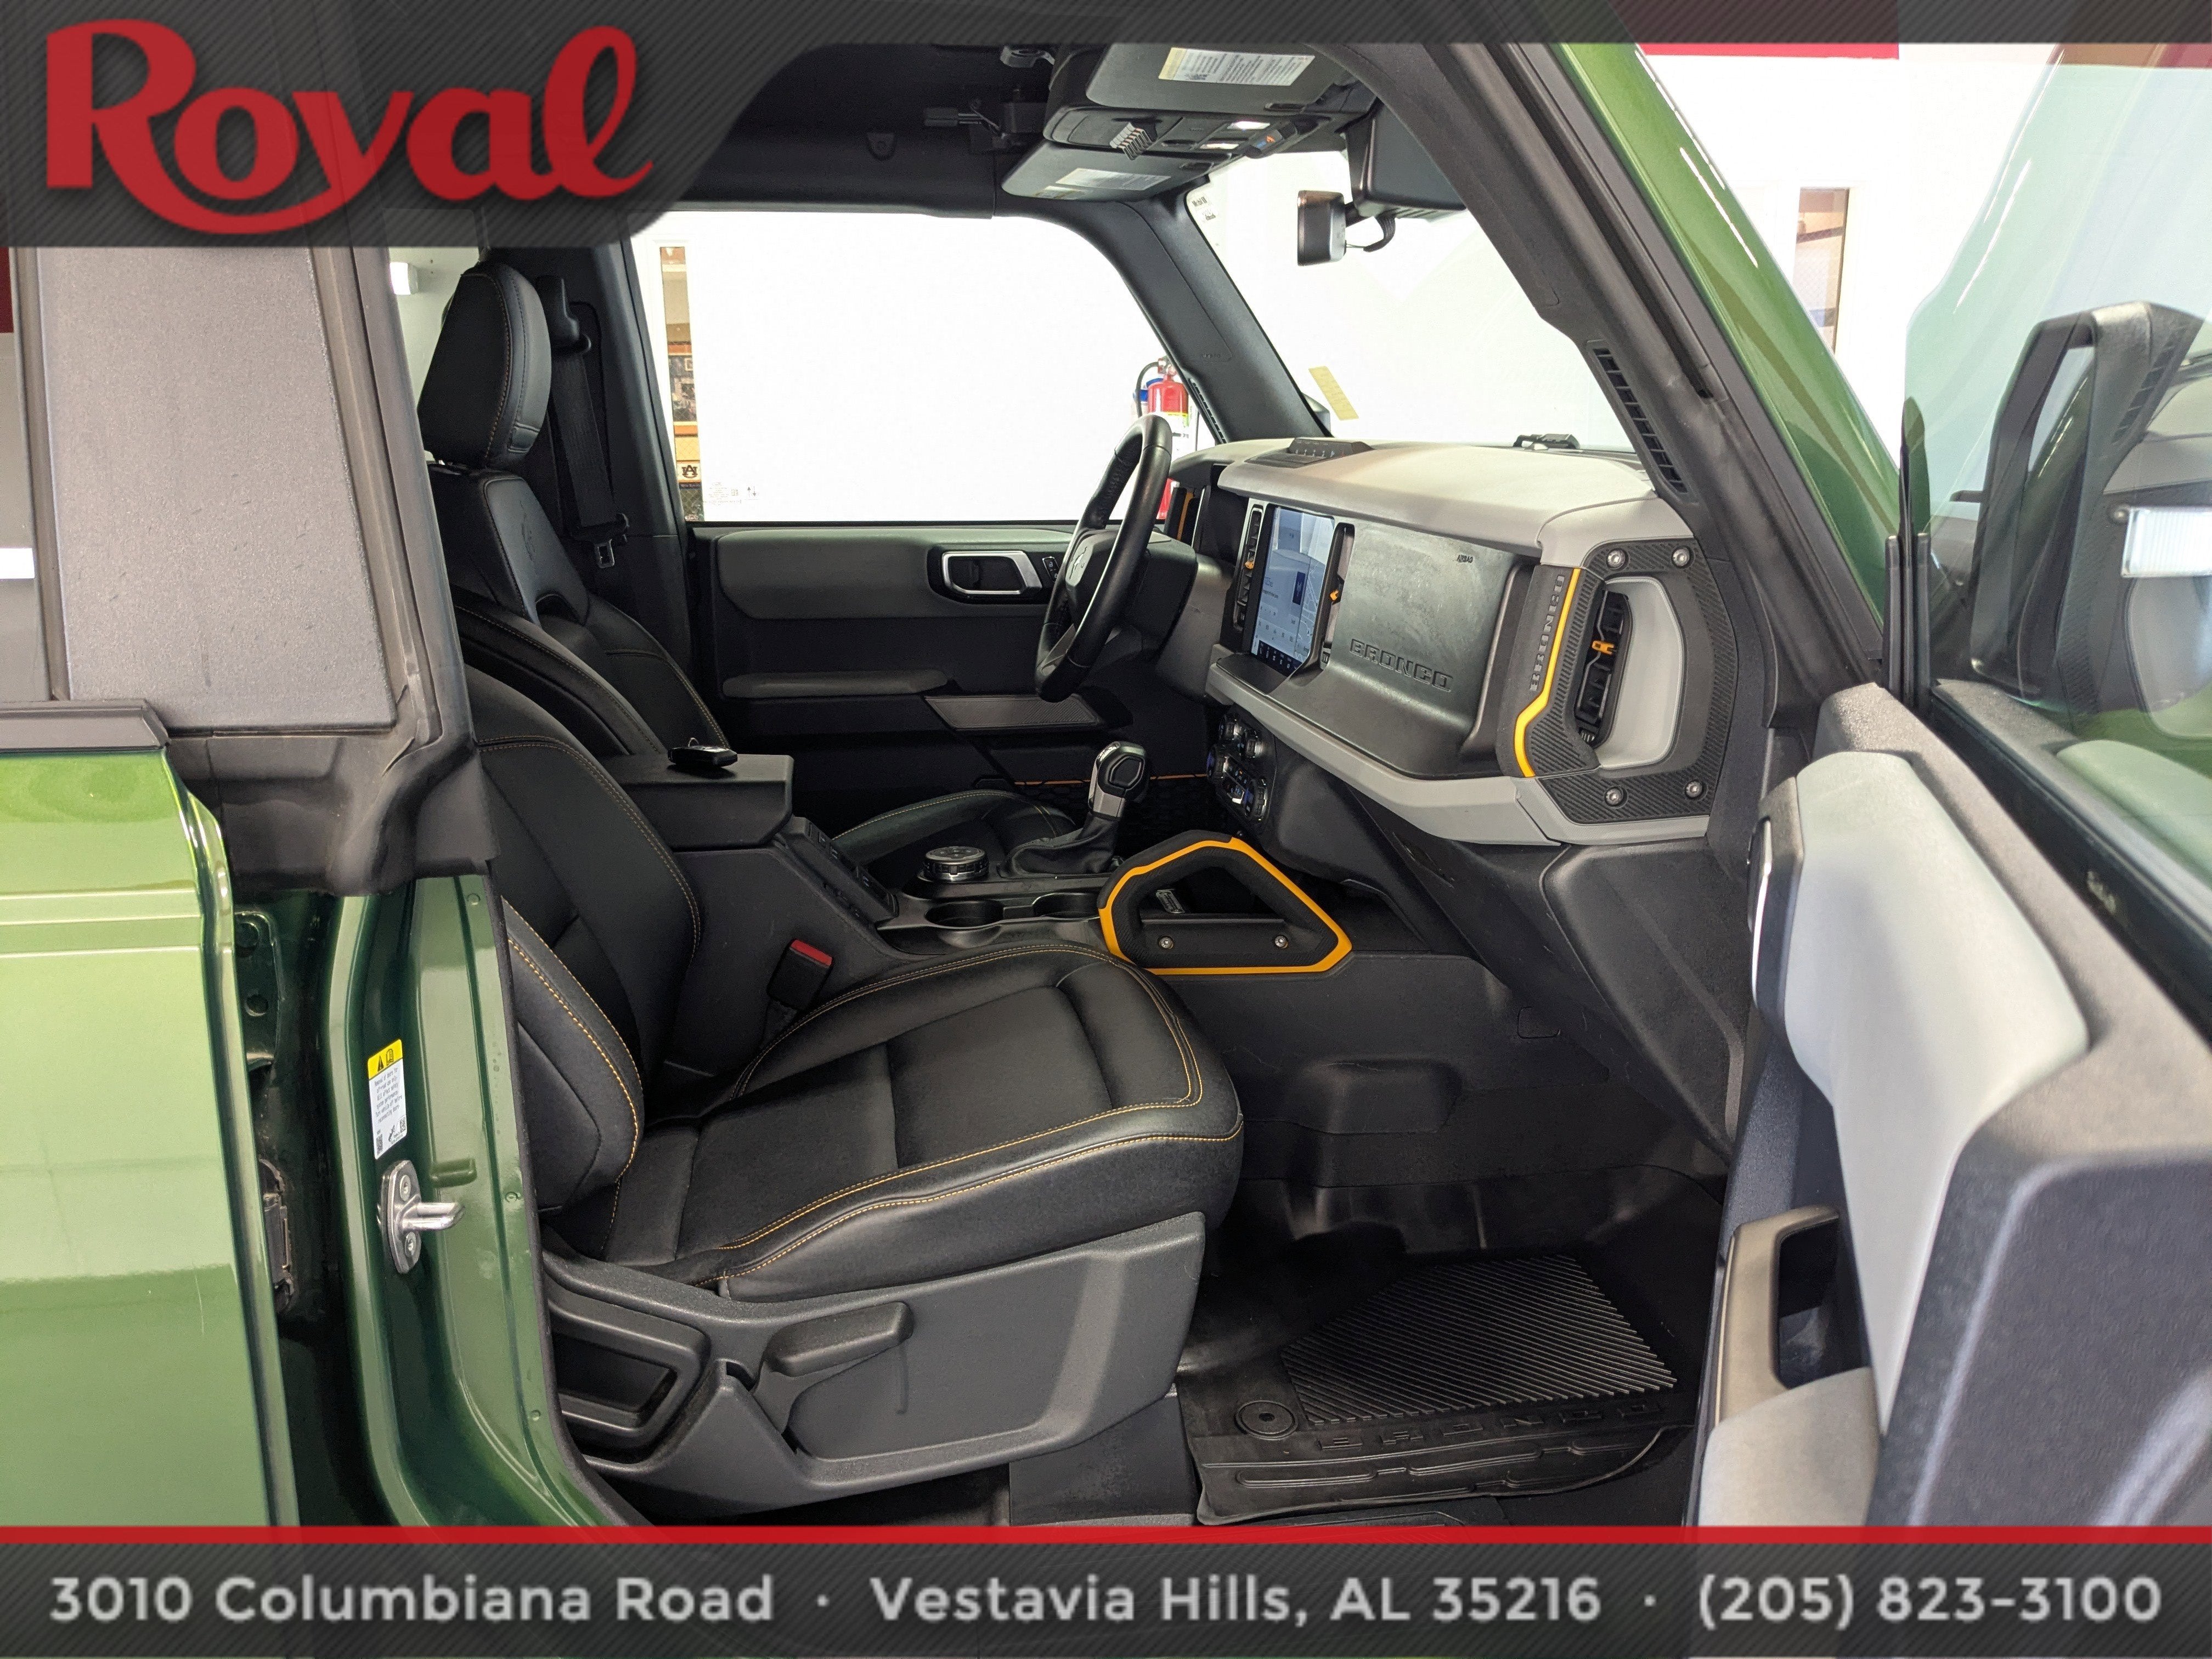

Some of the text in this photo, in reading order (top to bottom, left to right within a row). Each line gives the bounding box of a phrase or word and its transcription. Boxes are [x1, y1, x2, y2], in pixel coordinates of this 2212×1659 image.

[1529, 575, 1565, 691] BRONCO
[1350, 639, 1453, 692] BRONCO
[1316, 1401, 1663, 1451] BRONCO
